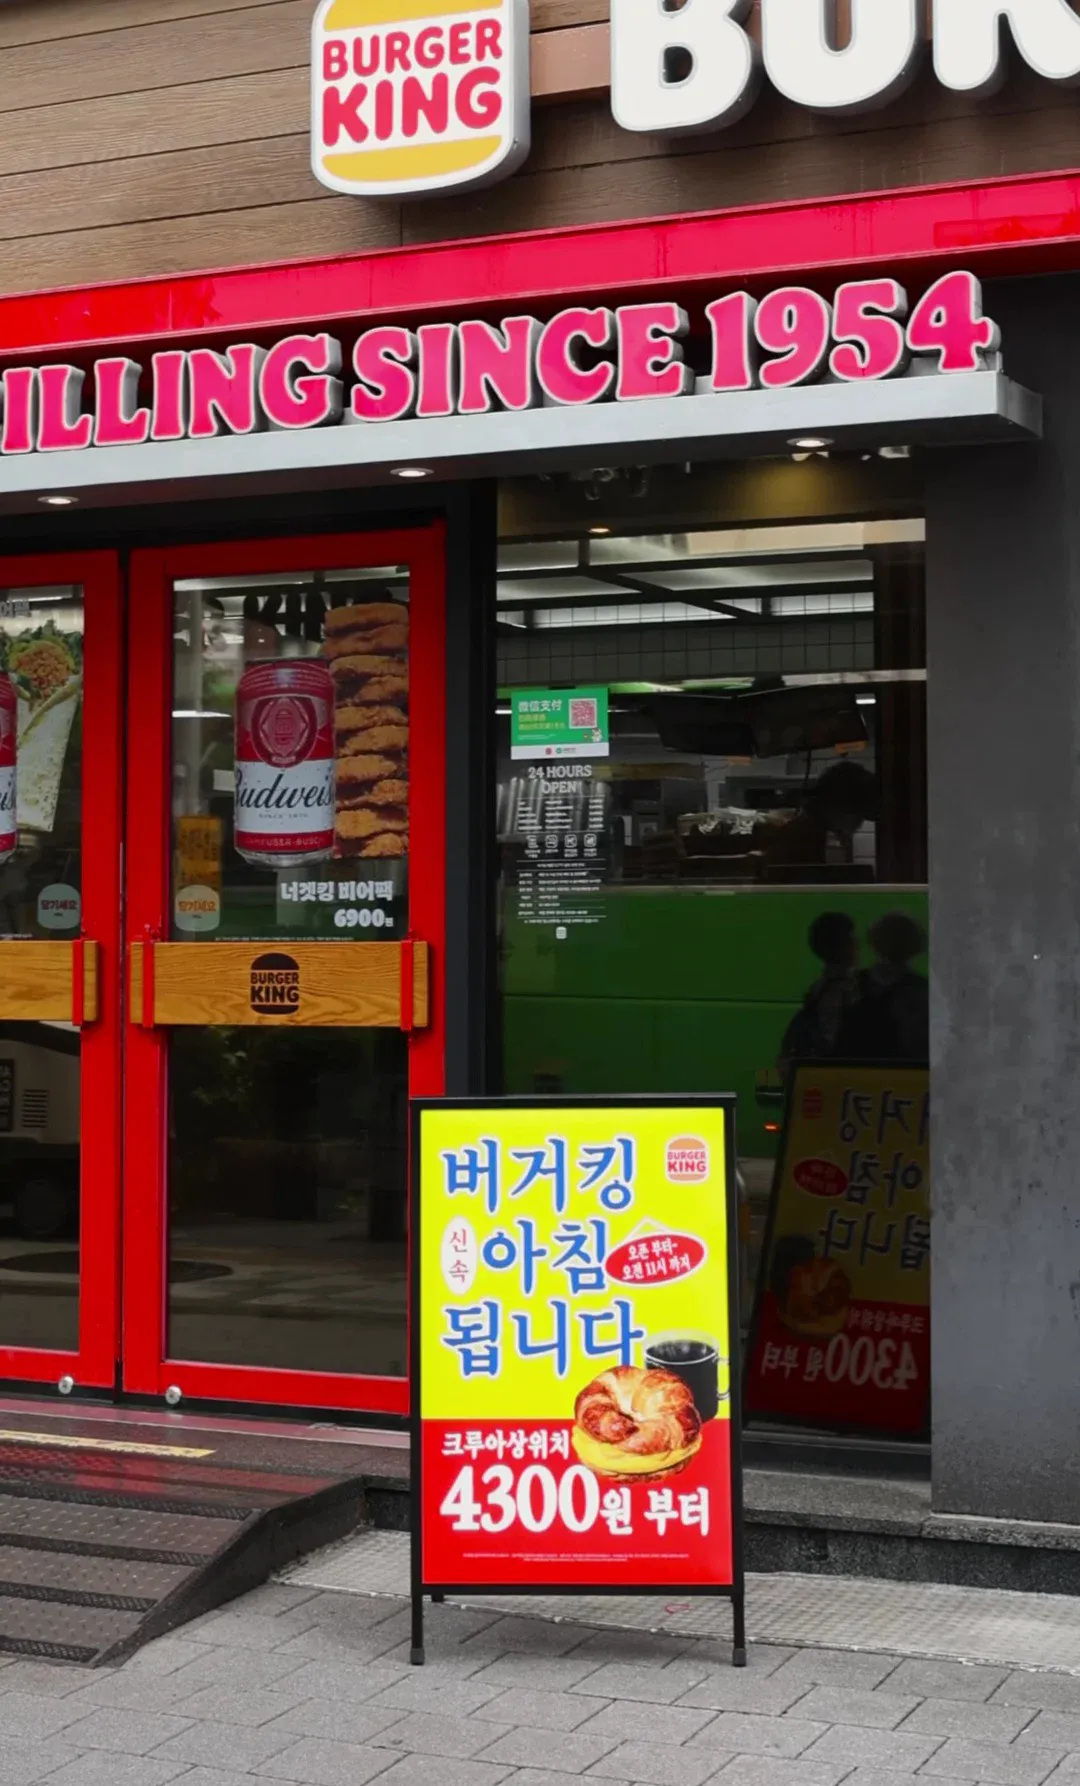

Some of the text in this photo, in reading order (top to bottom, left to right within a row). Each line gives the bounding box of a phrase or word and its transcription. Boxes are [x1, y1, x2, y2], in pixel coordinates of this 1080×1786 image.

[322, 18, 503, 81] BURGER
[322, 66, 503, 147] KING
[351, 302, 685, 423] SINCE
[705, 270, 993, 392] 1954
[518, 699, 562, 713] 微信支付
[528, 765, 593, 779] 24 HOURS
[541, 780, 579, 794] OPEN
[280, 881, 394, 902] 너겟킹 비어팩
[250, 972, 300, 984] BURGER
[250, 985, 300, 1003] KING
[667, 1151, 706, 1160] BURGER
[667, 1161, 707, 1173] KING
[442, 1137, 633, 1214] 버거킹
[448, 1228, 469, 1284] 신속
[482, 1218, 606, 1295] 아침
[442, 1300, 645, 1376] 됩니다
[441, 1429, 570, 1460] 크루아상위치
[643, 1487, 710, 1536] 부터
